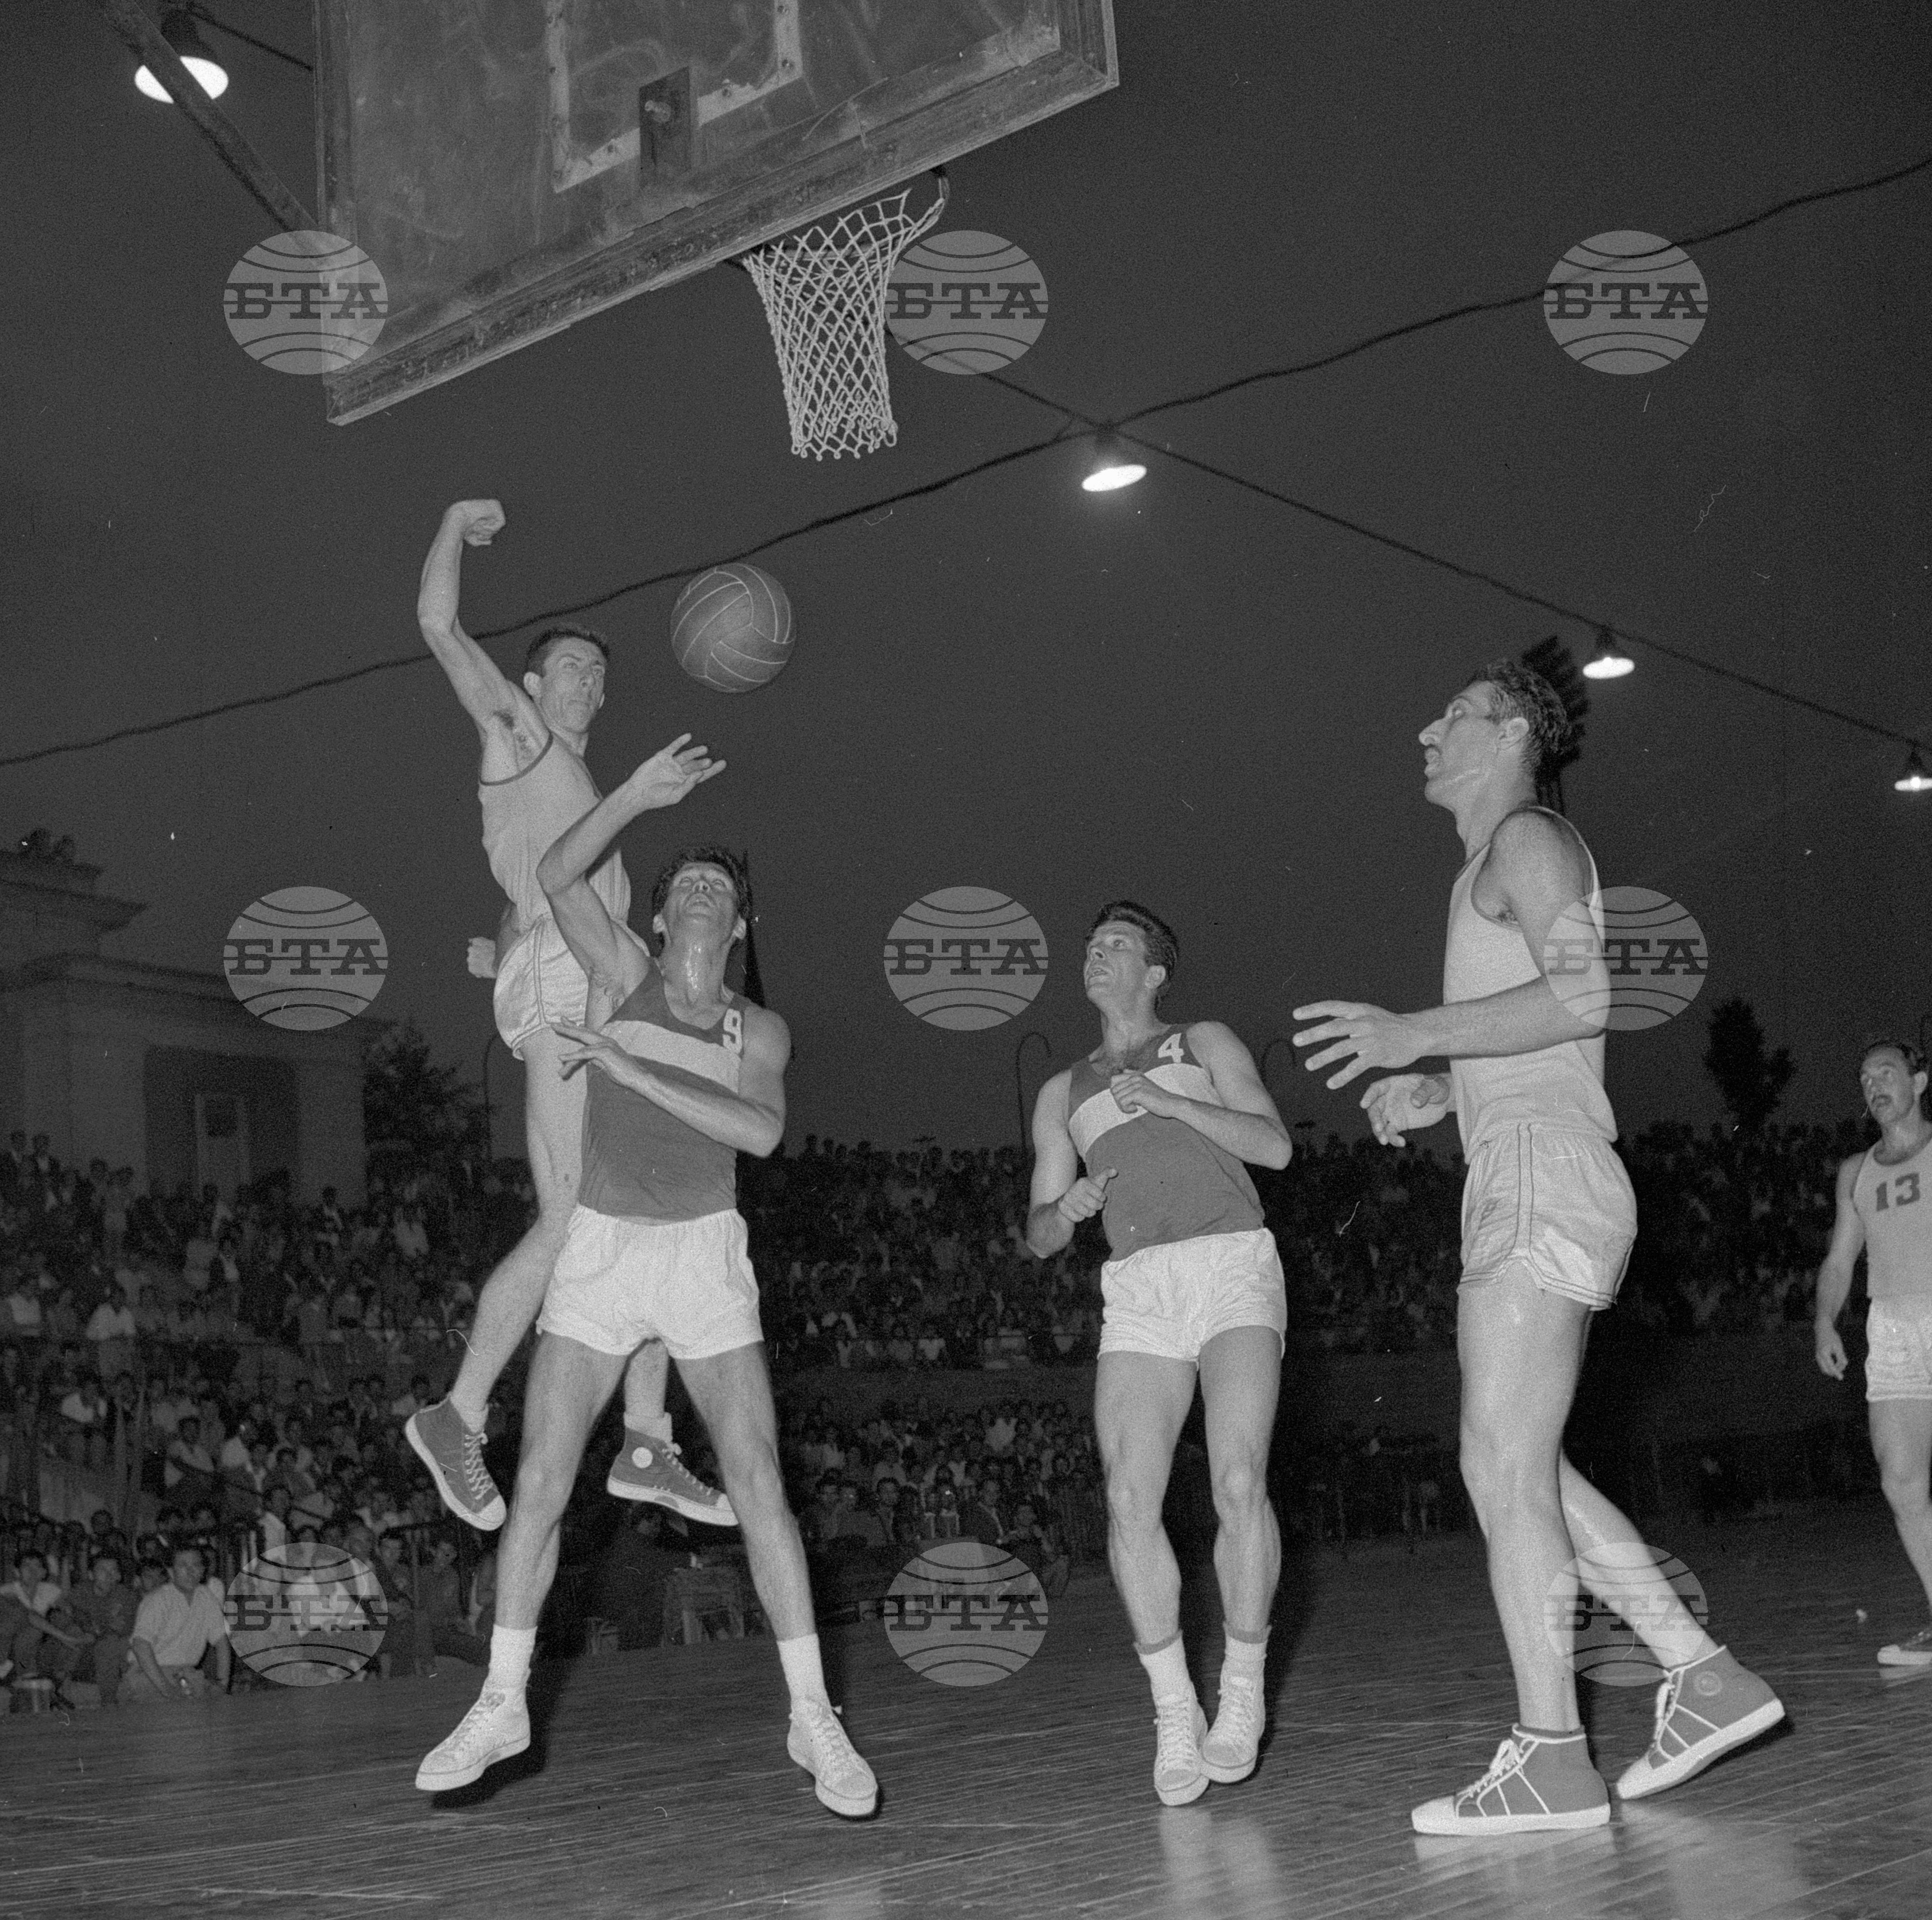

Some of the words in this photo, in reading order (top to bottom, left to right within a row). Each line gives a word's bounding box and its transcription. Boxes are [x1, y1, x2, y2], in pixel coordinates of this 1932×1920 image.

[723, 1008, 743, 1054] 9
[1158, 1033, 1184, 1063] 4
[1876, 1172, 1920, 1211] 13
